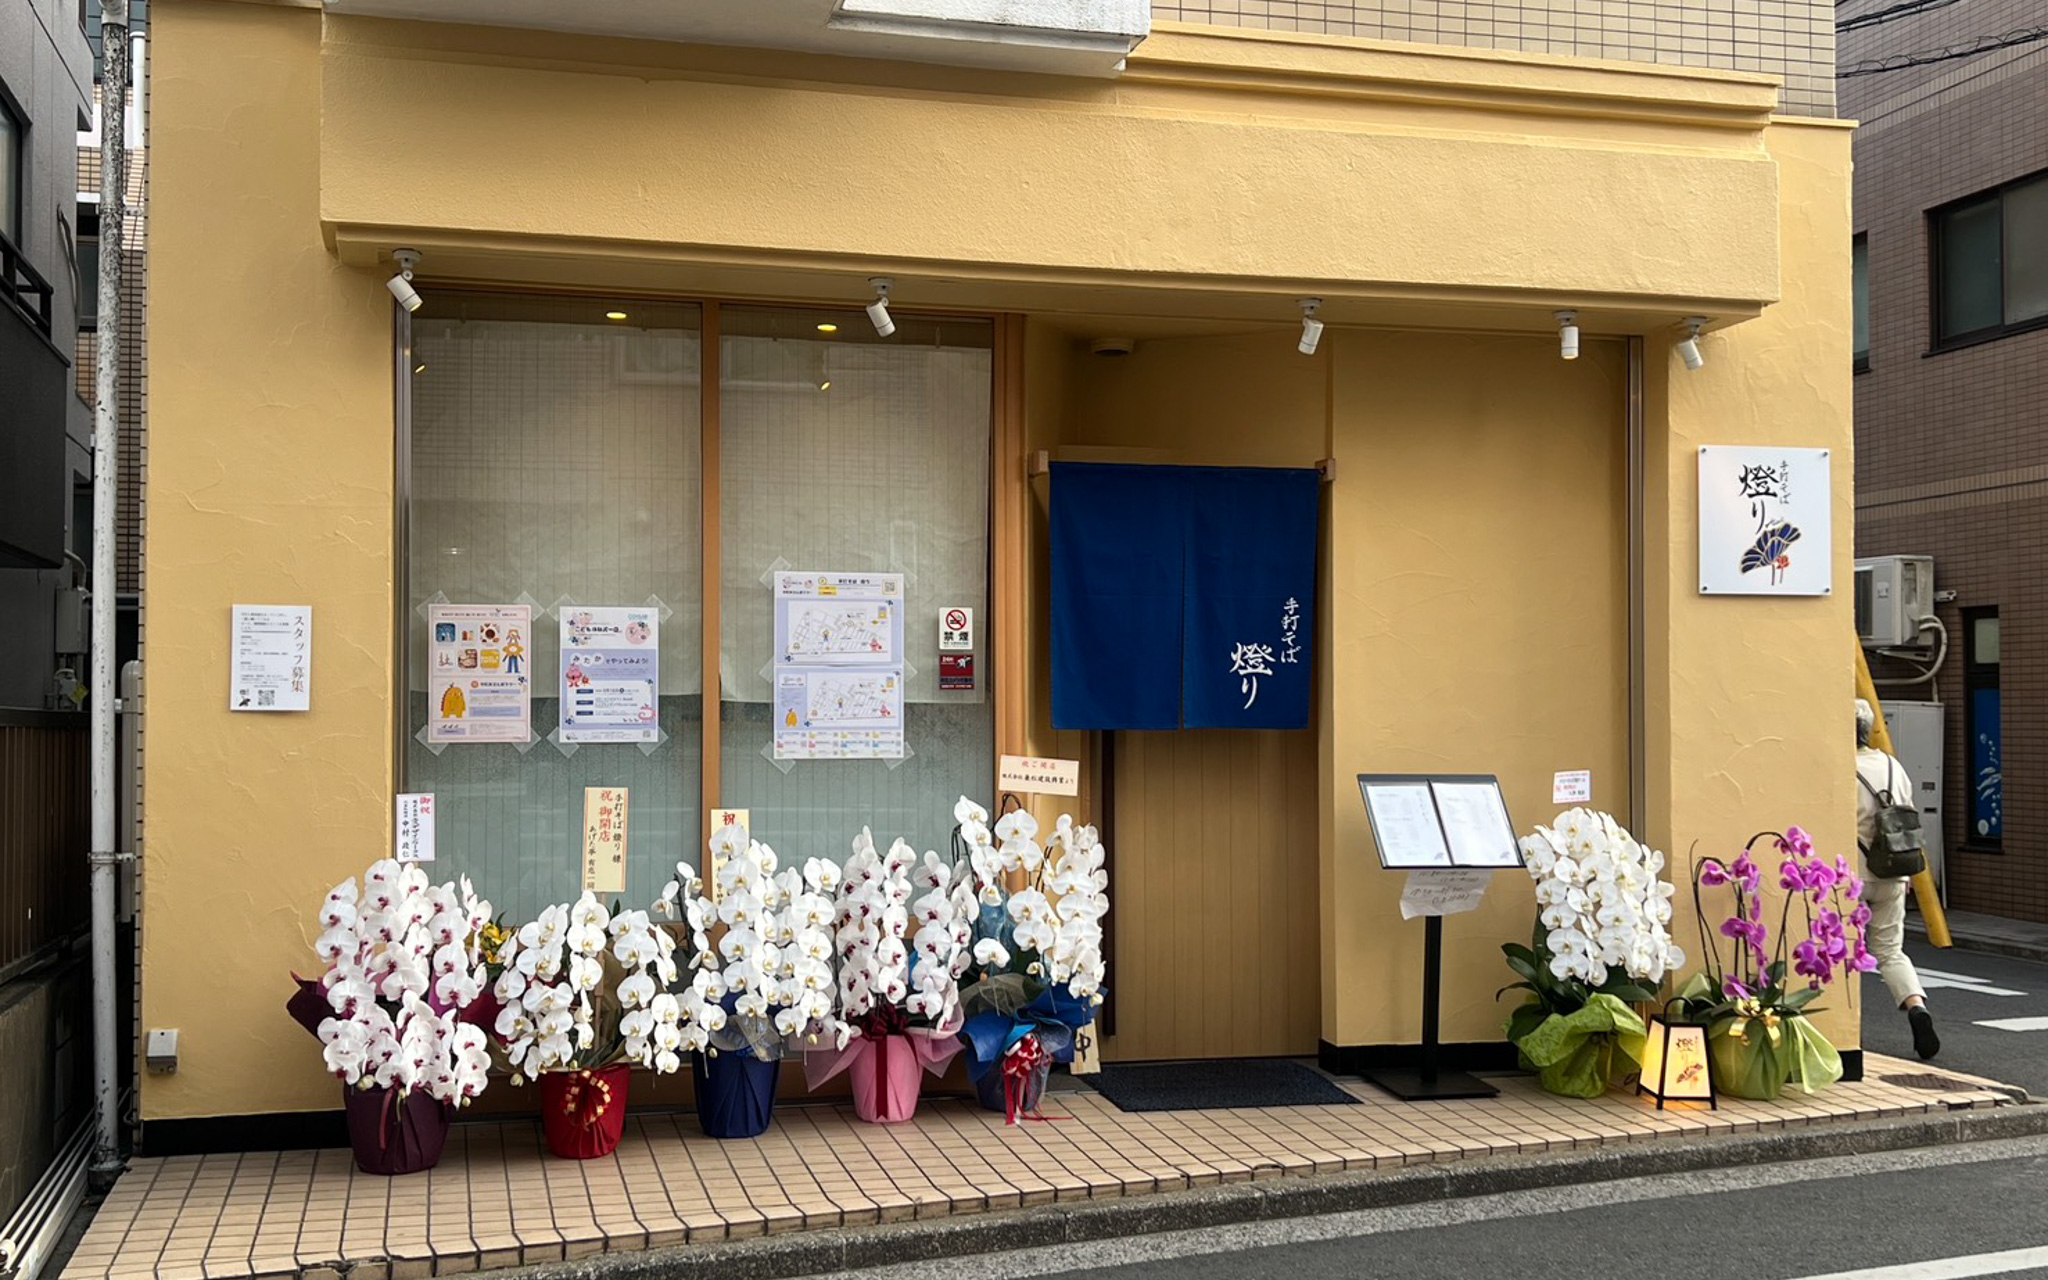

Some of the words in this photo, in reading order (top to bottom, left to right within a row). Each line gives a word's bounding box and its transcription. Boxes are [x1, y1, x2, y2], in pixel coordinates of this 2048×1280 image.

[1738, 464, 1780, 535] 燈り
[1779, 460, 1792, 505] 手打そば
[291, 615, 305, 693] スタッフ募集
[1280, 597, 1302, 664] 手打そば
[1229, 641, 1276, 710] 燈り
[600, 790, 613, 803] 祝
[613, 793, 624, 829] 手打そば
[722, 811, 736, 826] 祝
